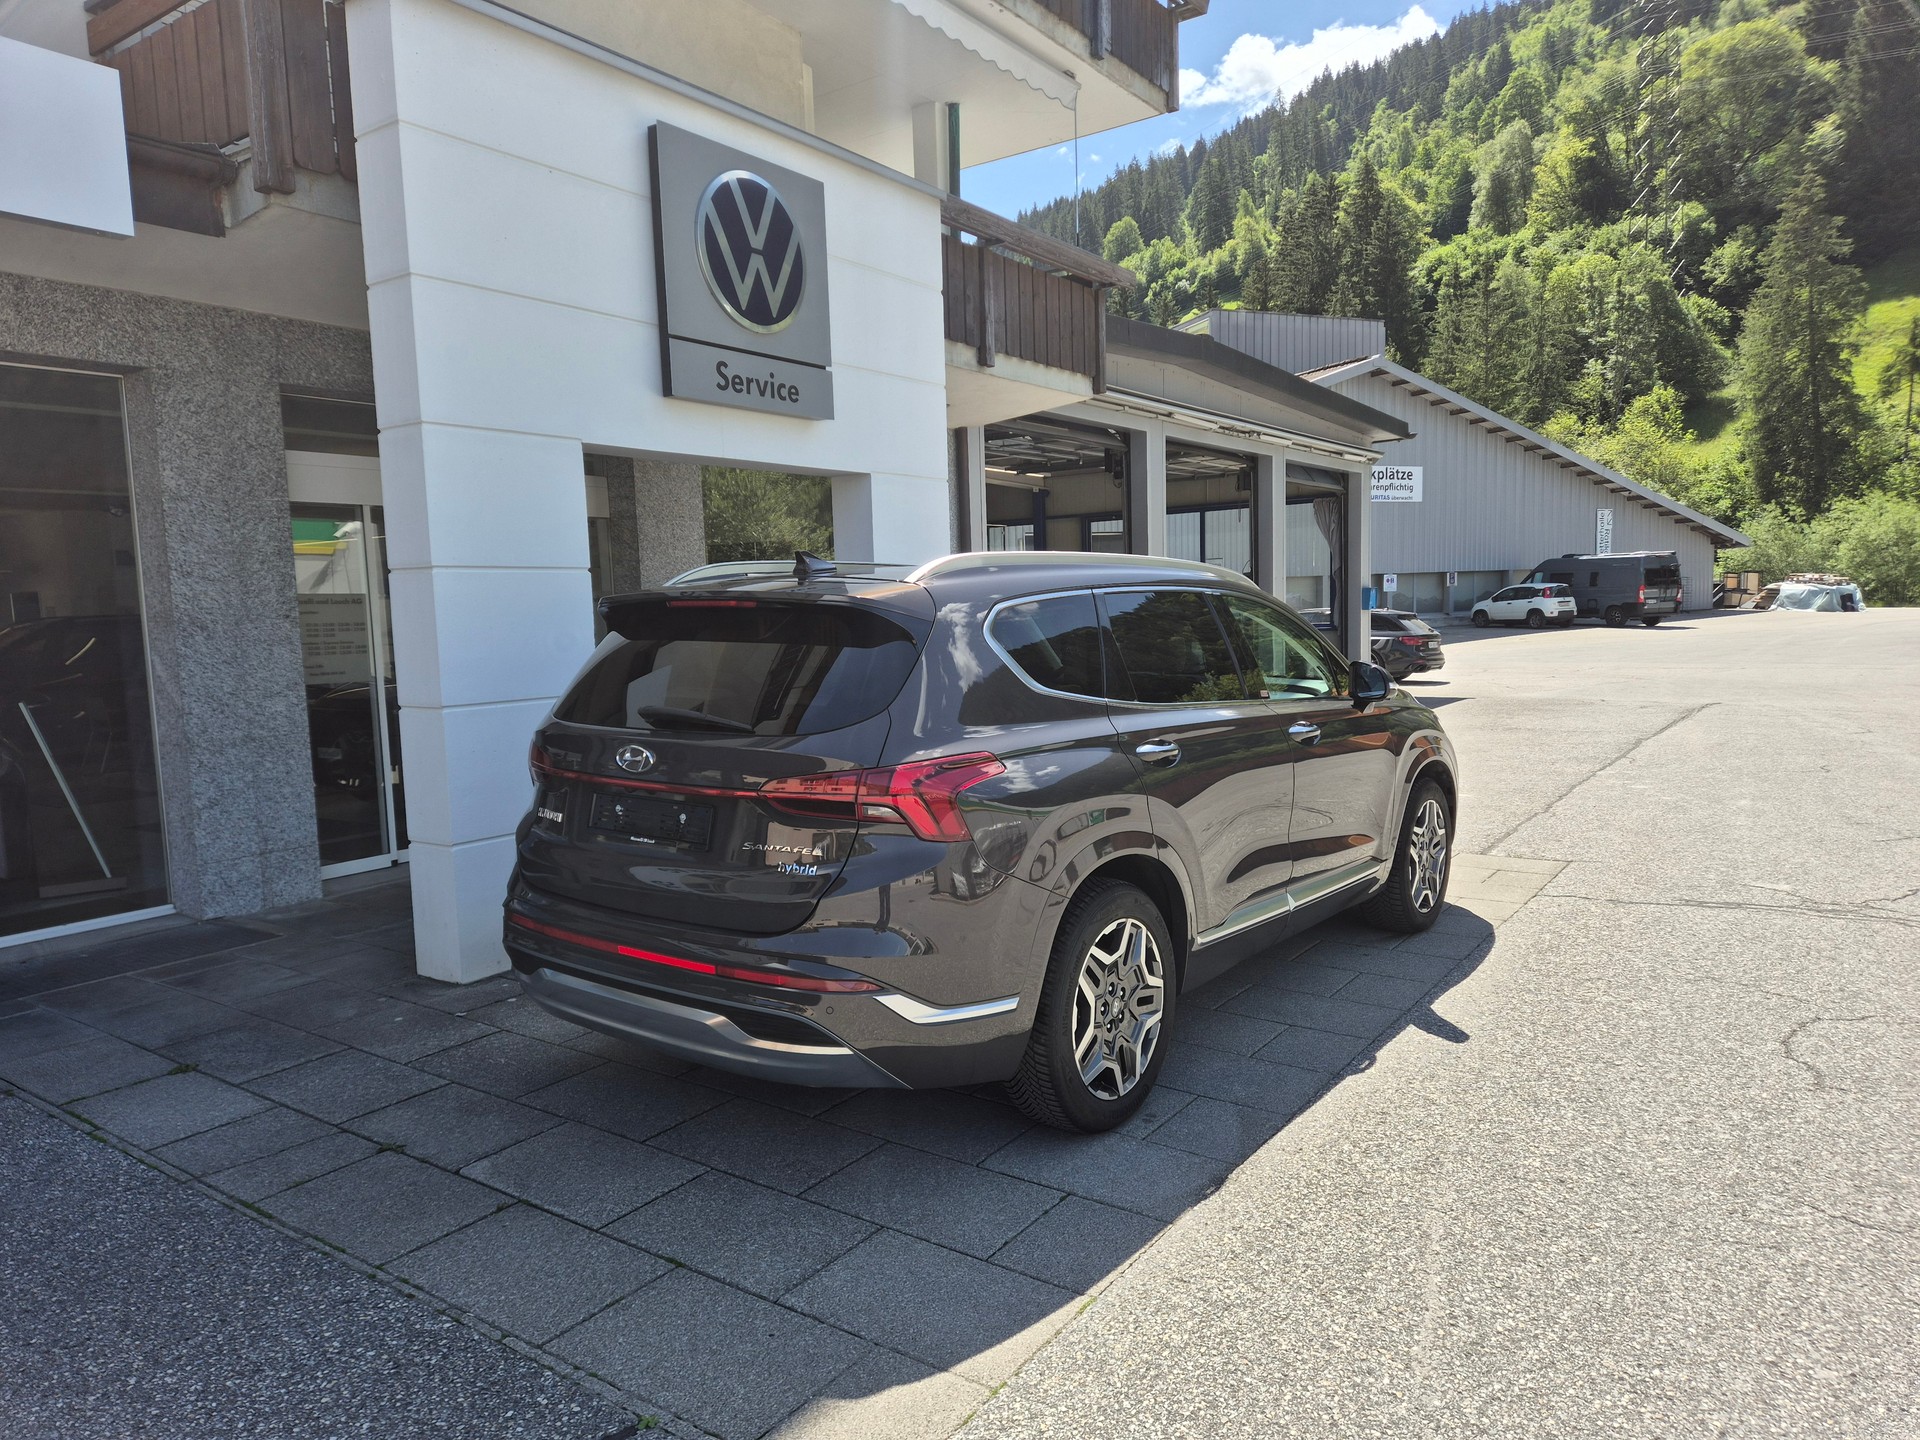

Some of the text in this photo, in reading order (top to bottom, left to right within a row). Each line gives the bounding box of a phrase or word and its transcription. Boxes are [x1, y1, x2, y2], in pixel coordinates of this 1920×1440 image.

[715, 360, 799, 403] Service
[1371, 467, 1413, 483] kplätze
[777, 861, 817, 876] hybrid
